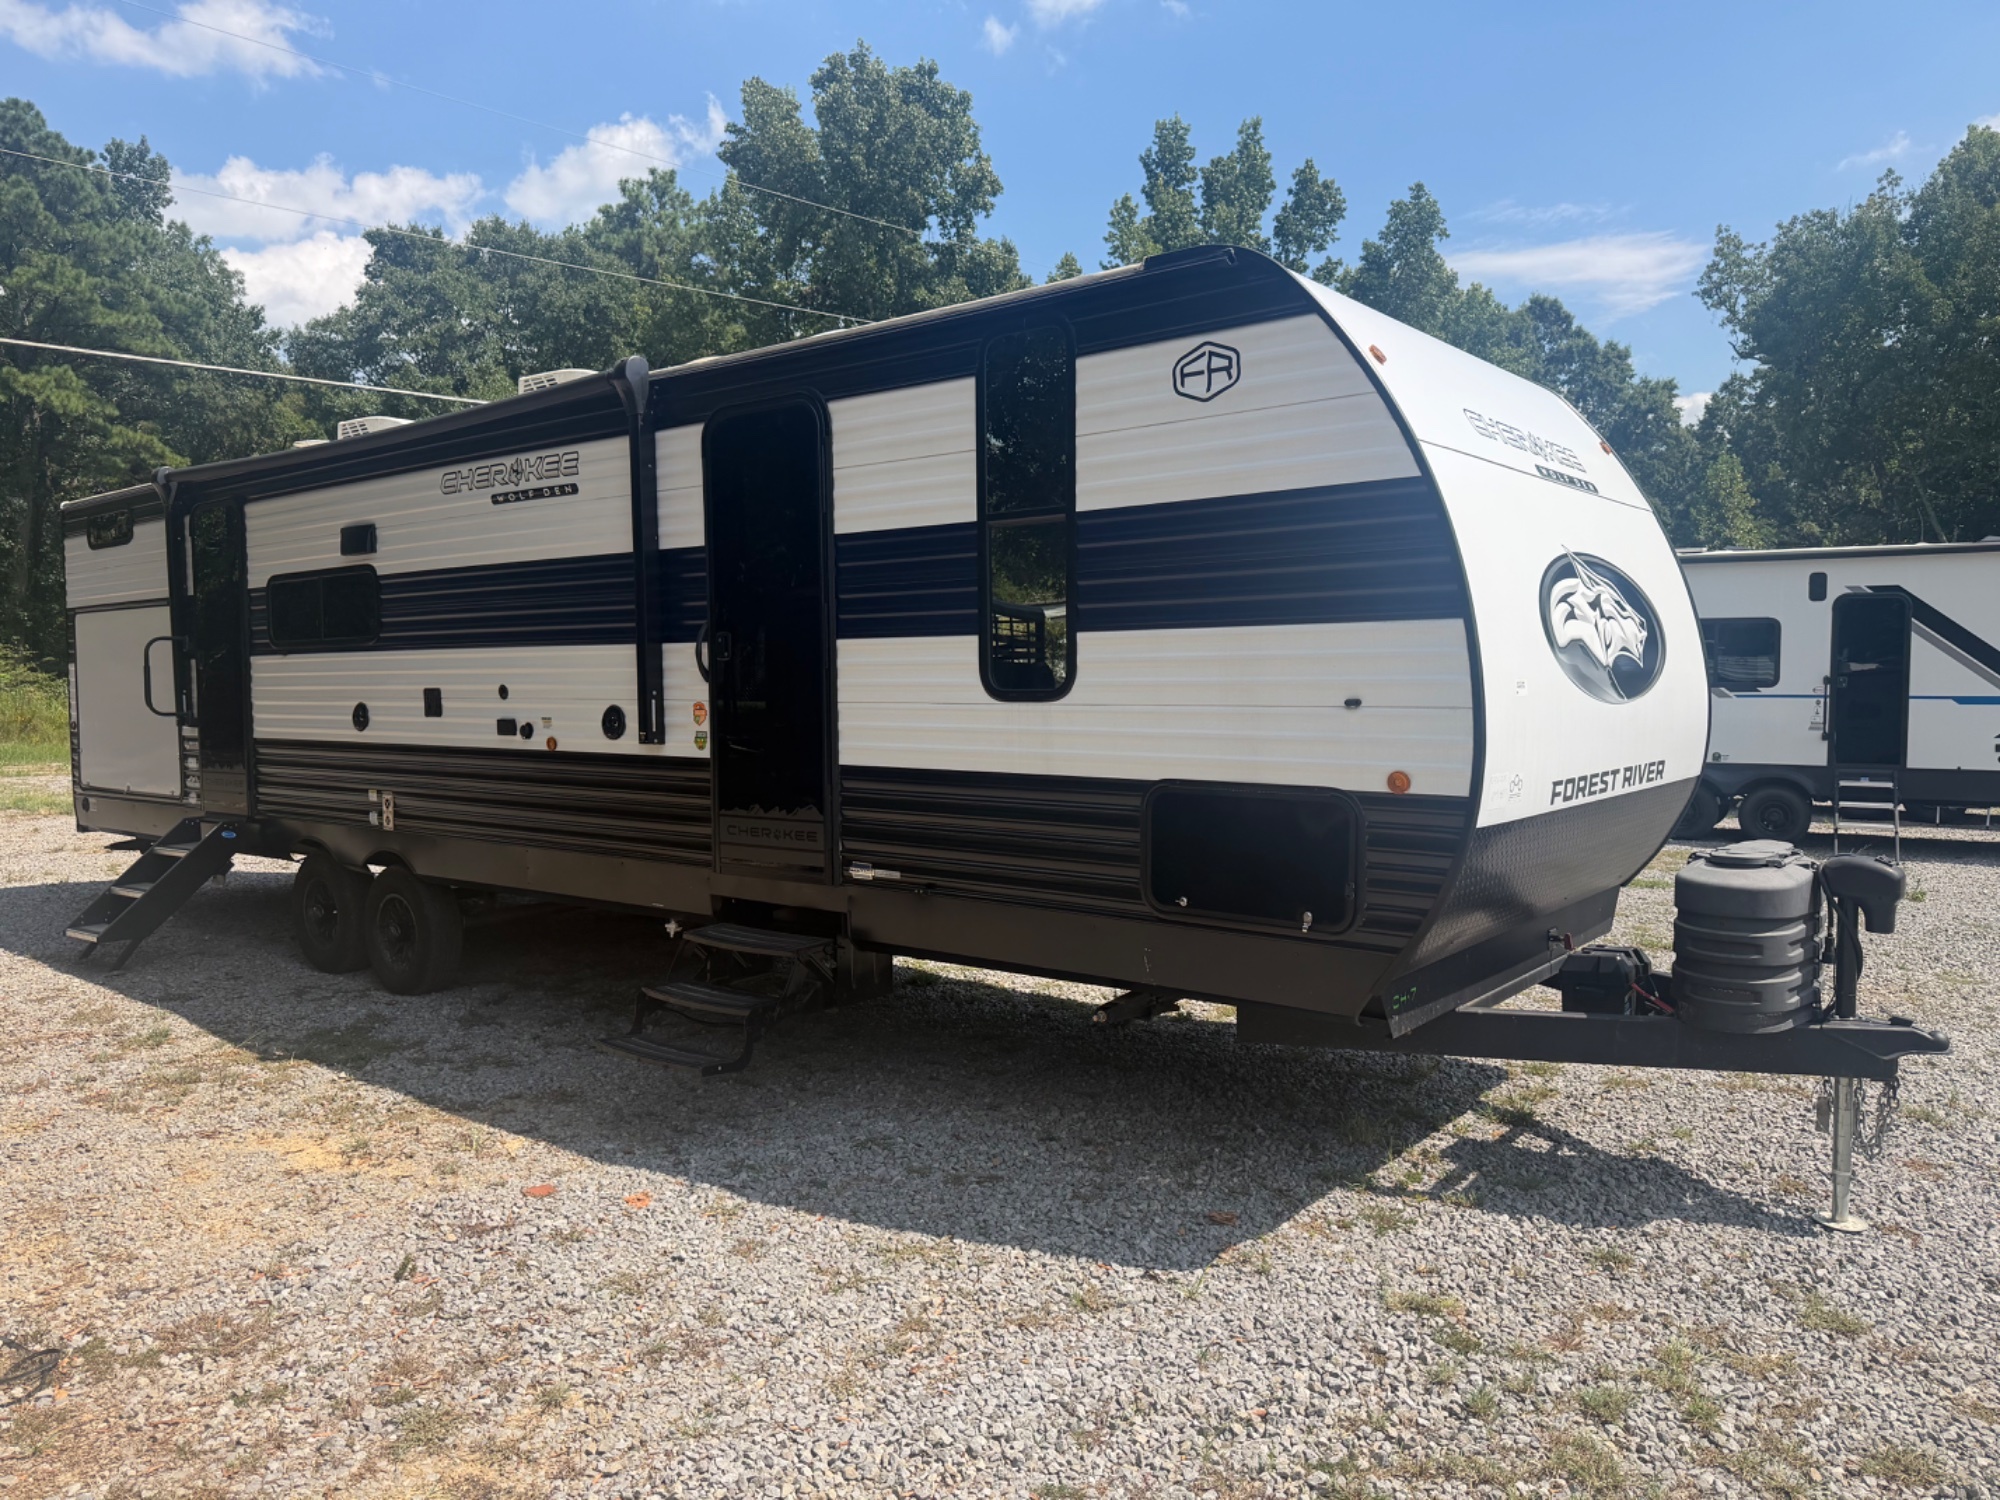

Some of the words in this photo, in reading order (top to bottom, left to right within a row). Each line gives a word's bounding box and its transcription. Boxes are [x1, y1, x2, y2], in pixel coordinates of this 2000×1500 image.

[1180, 349, 1234, 394] FR
[496, 488, 535, 503] WOLF
[542, 485, 573, 498] DEN
[1550, 768, 1621, 805] FOREST
[1622, 759, 1666, 789] RIVER
